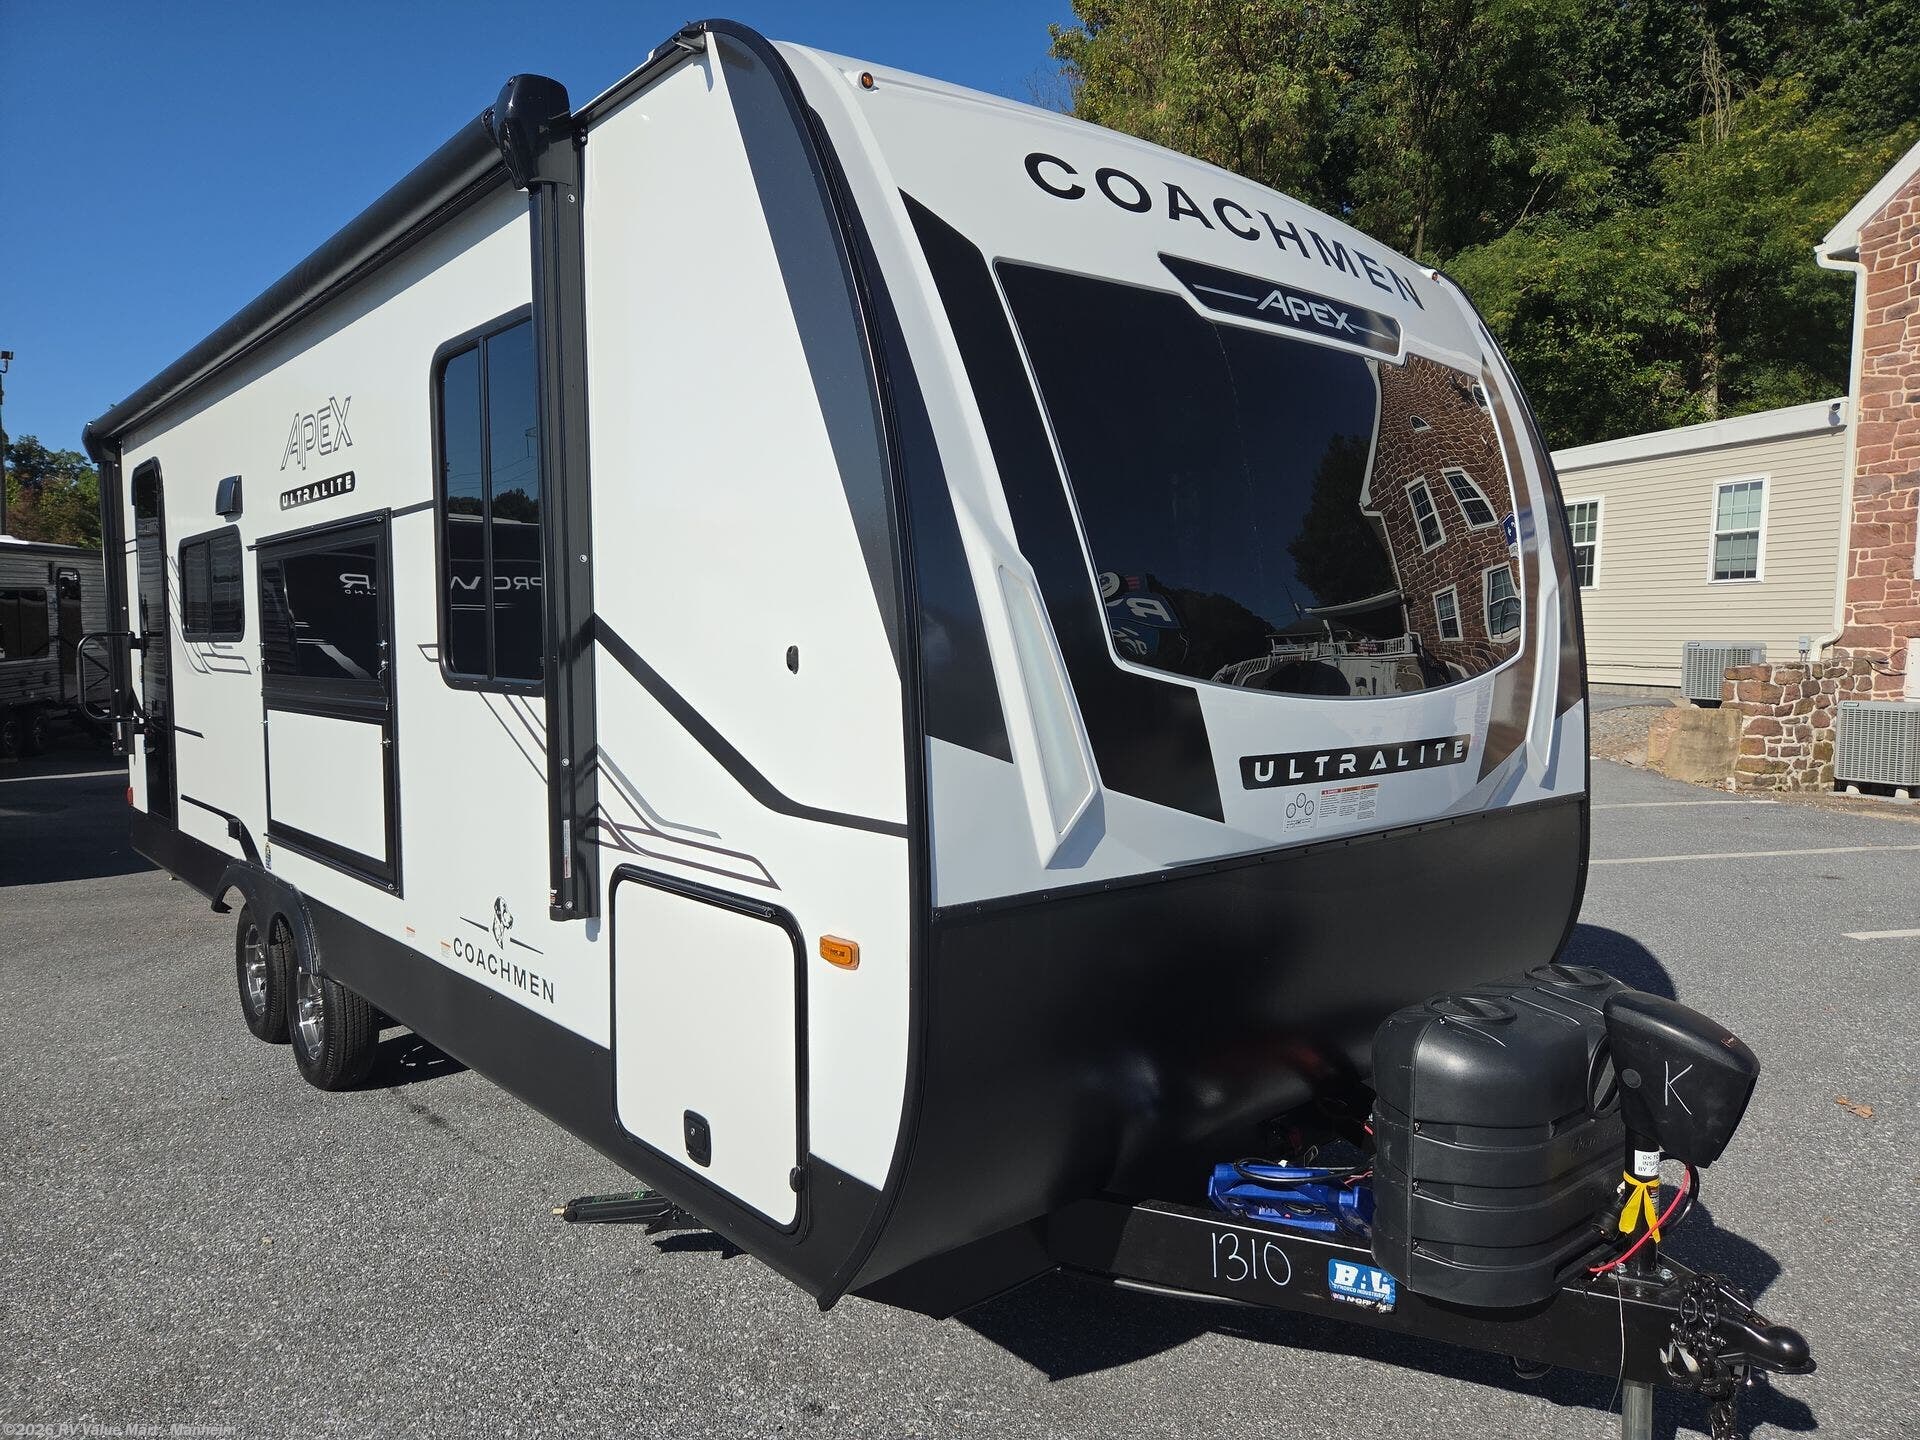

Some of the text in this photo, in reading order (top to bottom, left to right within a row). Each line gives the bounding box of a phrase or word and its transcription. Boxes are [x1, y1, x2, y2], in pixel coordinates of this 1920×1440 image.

[1024, 152, 1425, 310] COACHMEN
[1256, 289, 1356, 334] APEX
[280, 396, 353, 471] APEX
[282, 474, 352, 507] ULTRALITE
[1254, 739, 1464, 782] ULTRALITE
[453, 937, 554, 1004] COACHMEN
[1664, 1060, 1693, 1115] K
[1212, 1232, 1291, 1286] 1310
